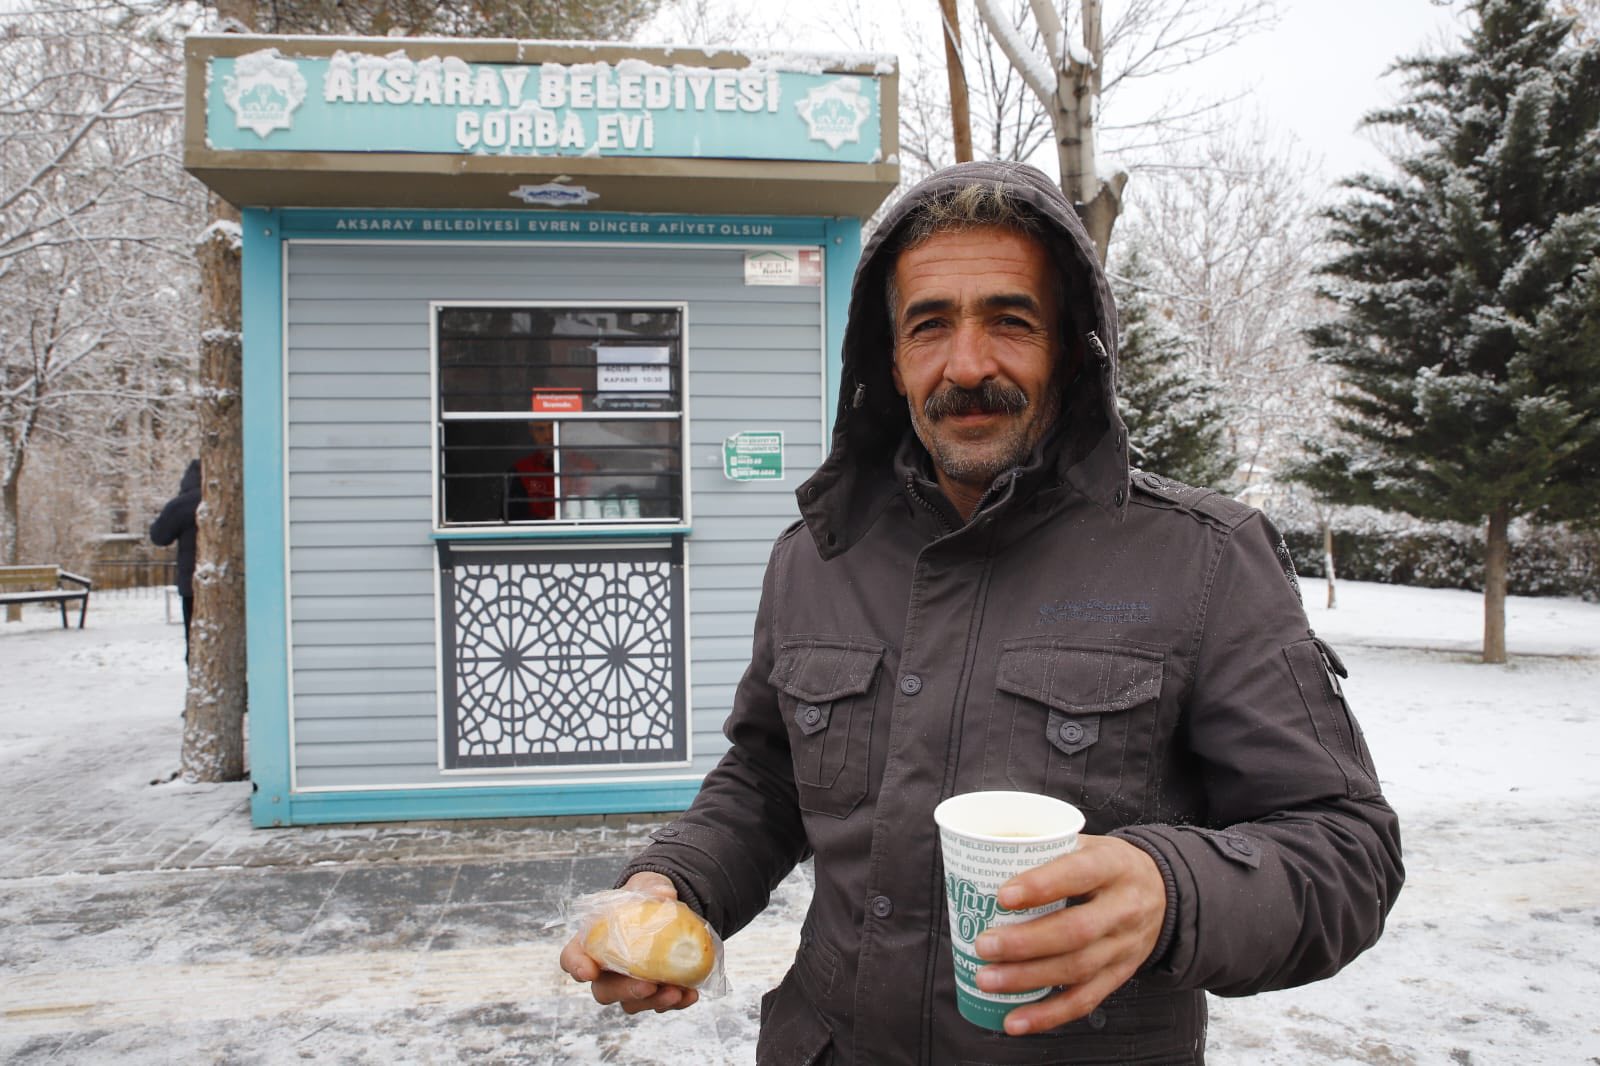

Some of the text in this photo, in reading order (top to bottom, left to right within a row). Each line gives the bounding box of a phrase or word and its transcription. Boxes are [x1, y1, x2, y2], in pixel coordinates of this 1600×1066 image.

[325, 63, 780, 113] AKSARAY BELEDİYESİ
[456, 110, 655, 149] ÇORBA EVİ
[336, 218, 773, 236] AKSARAY BELEDİYESİ EVREN DİNÇER AFİYET OLSUN
[960, 839, 1019, 854] BELEDİYESİ
[1024, 840, 1068, 853] AKSARAY
[966, 854, 1014, 866] AKSARAY
